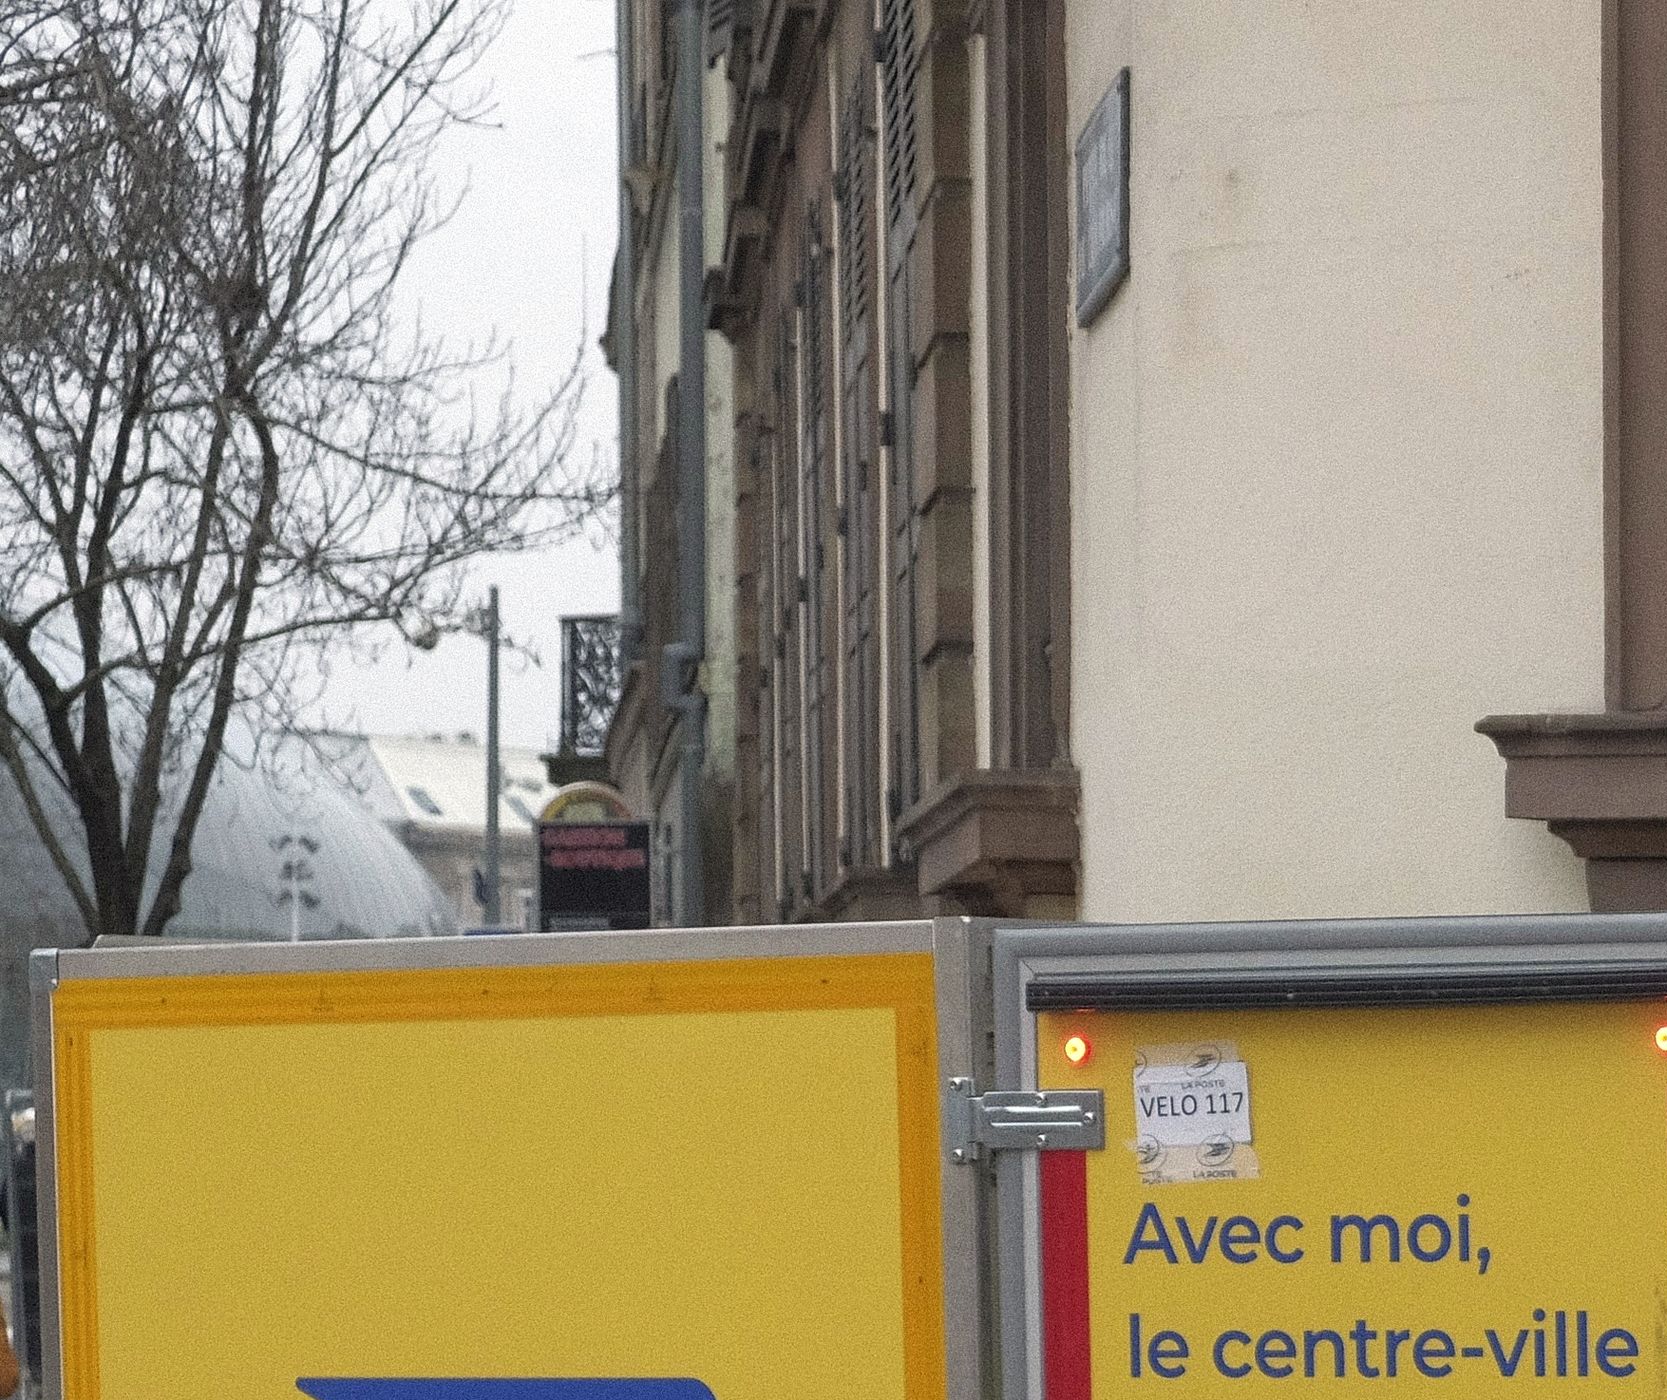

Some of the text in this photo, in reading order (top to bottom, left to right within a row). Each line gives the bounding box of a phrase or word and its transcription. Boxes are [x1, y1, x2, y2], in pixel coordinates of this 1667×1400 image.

[1140, 1091, 1243, 1118] VELO 117
[1123, 1193, 1492, 1274] Avec moi,
[1130, 1309, 1639, 1379] le centre-ville
